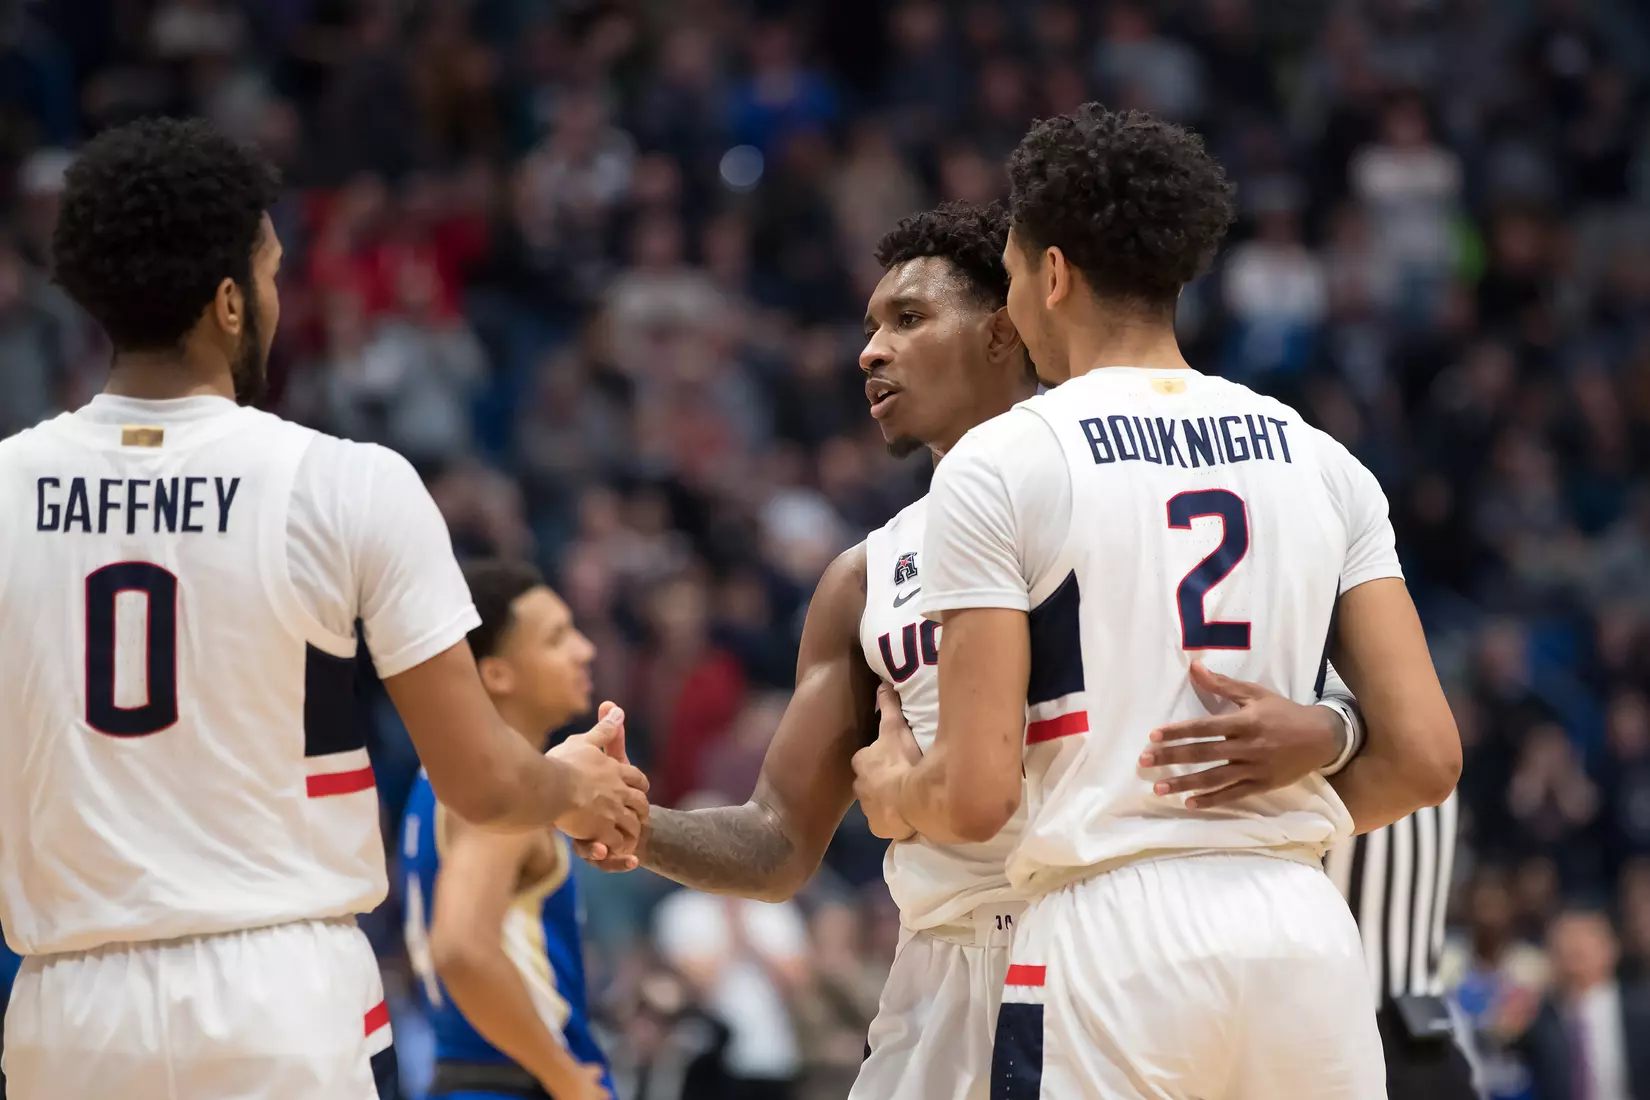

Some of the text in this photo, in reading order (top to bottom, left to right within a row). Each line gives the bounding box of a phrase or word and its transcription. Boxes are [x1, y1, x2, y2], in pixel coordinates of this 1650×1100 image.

[1079, 414, 1292, 468] BOUKNIGHT
[36, 477, 241, 534] GAFFNEY
[1166, 488, 1251, 650] 2
[85, 561, 179, 738] 0
